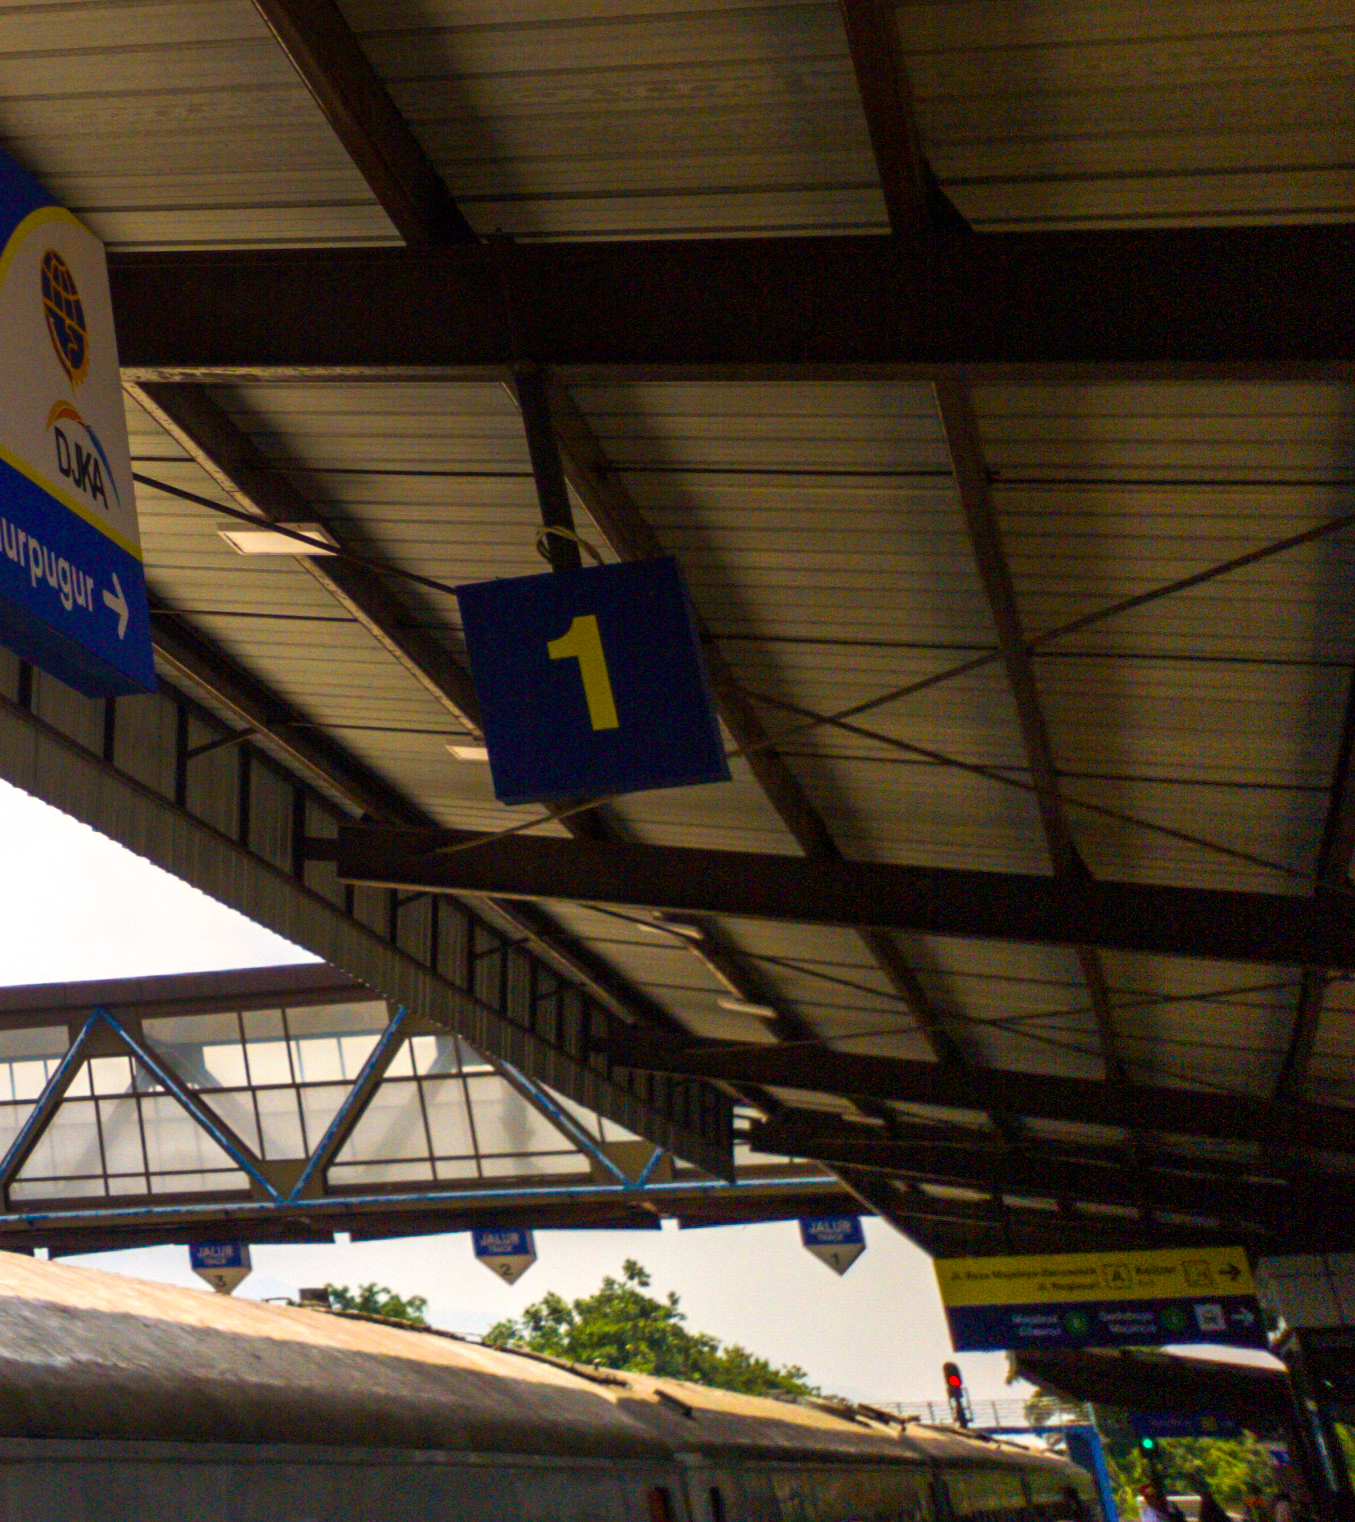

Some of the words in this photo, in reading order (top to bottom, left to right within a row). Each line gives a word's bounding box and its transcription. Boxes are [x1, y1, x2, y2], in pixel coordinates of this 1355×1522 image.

[53, 424, 109, 511] DJKA
[547, 614, 621, 731] 1
[214, 1274, 227, 1288] 3
[499, 1263, 513, 1276] 2
